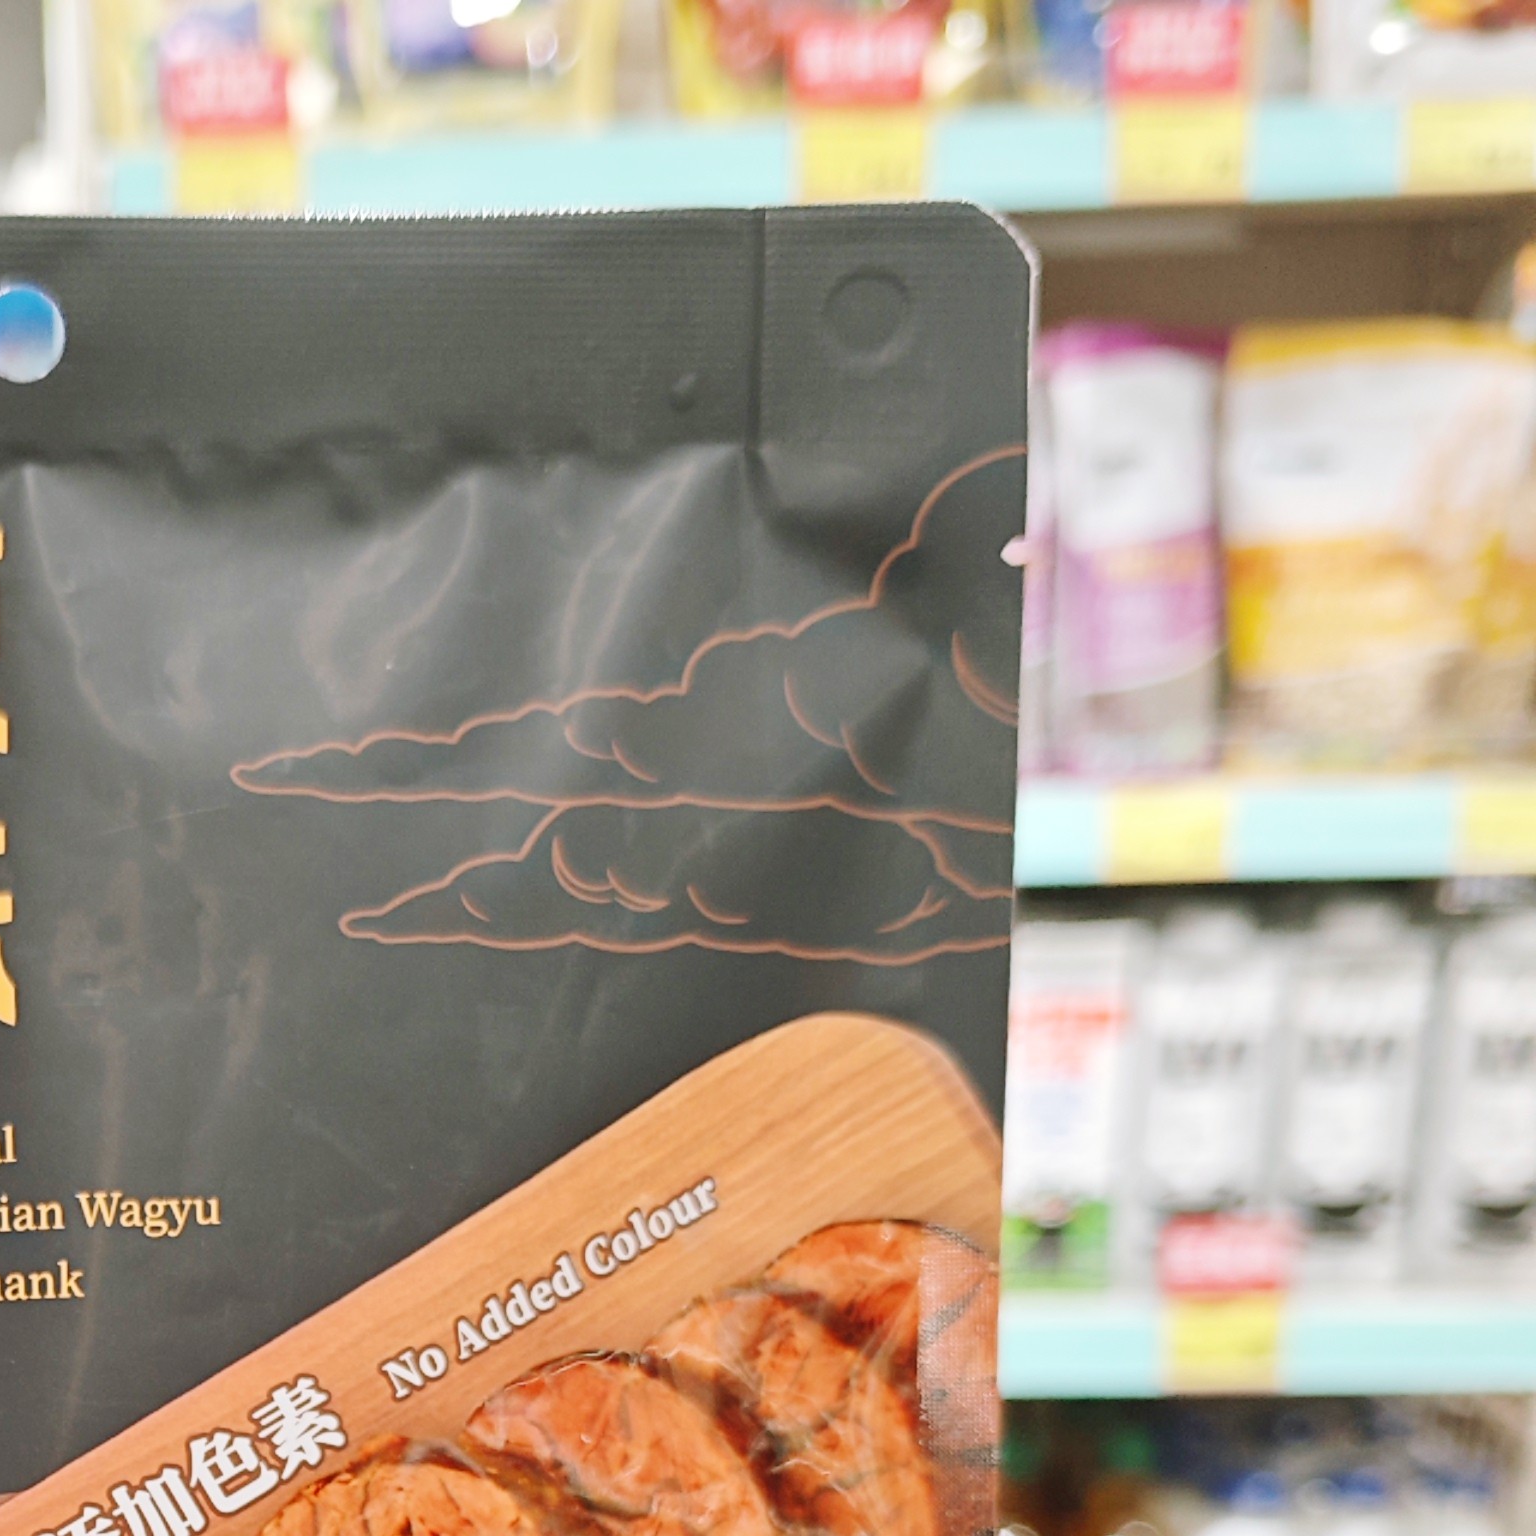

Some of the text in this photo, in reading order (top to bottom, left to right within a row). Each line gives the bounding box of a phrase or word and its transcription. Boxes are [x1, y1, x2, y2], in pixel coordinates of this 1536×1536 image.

[75, 1190, 223, 1239] Wagyu
[380, 1176, 719, 1400] No Added Colour
